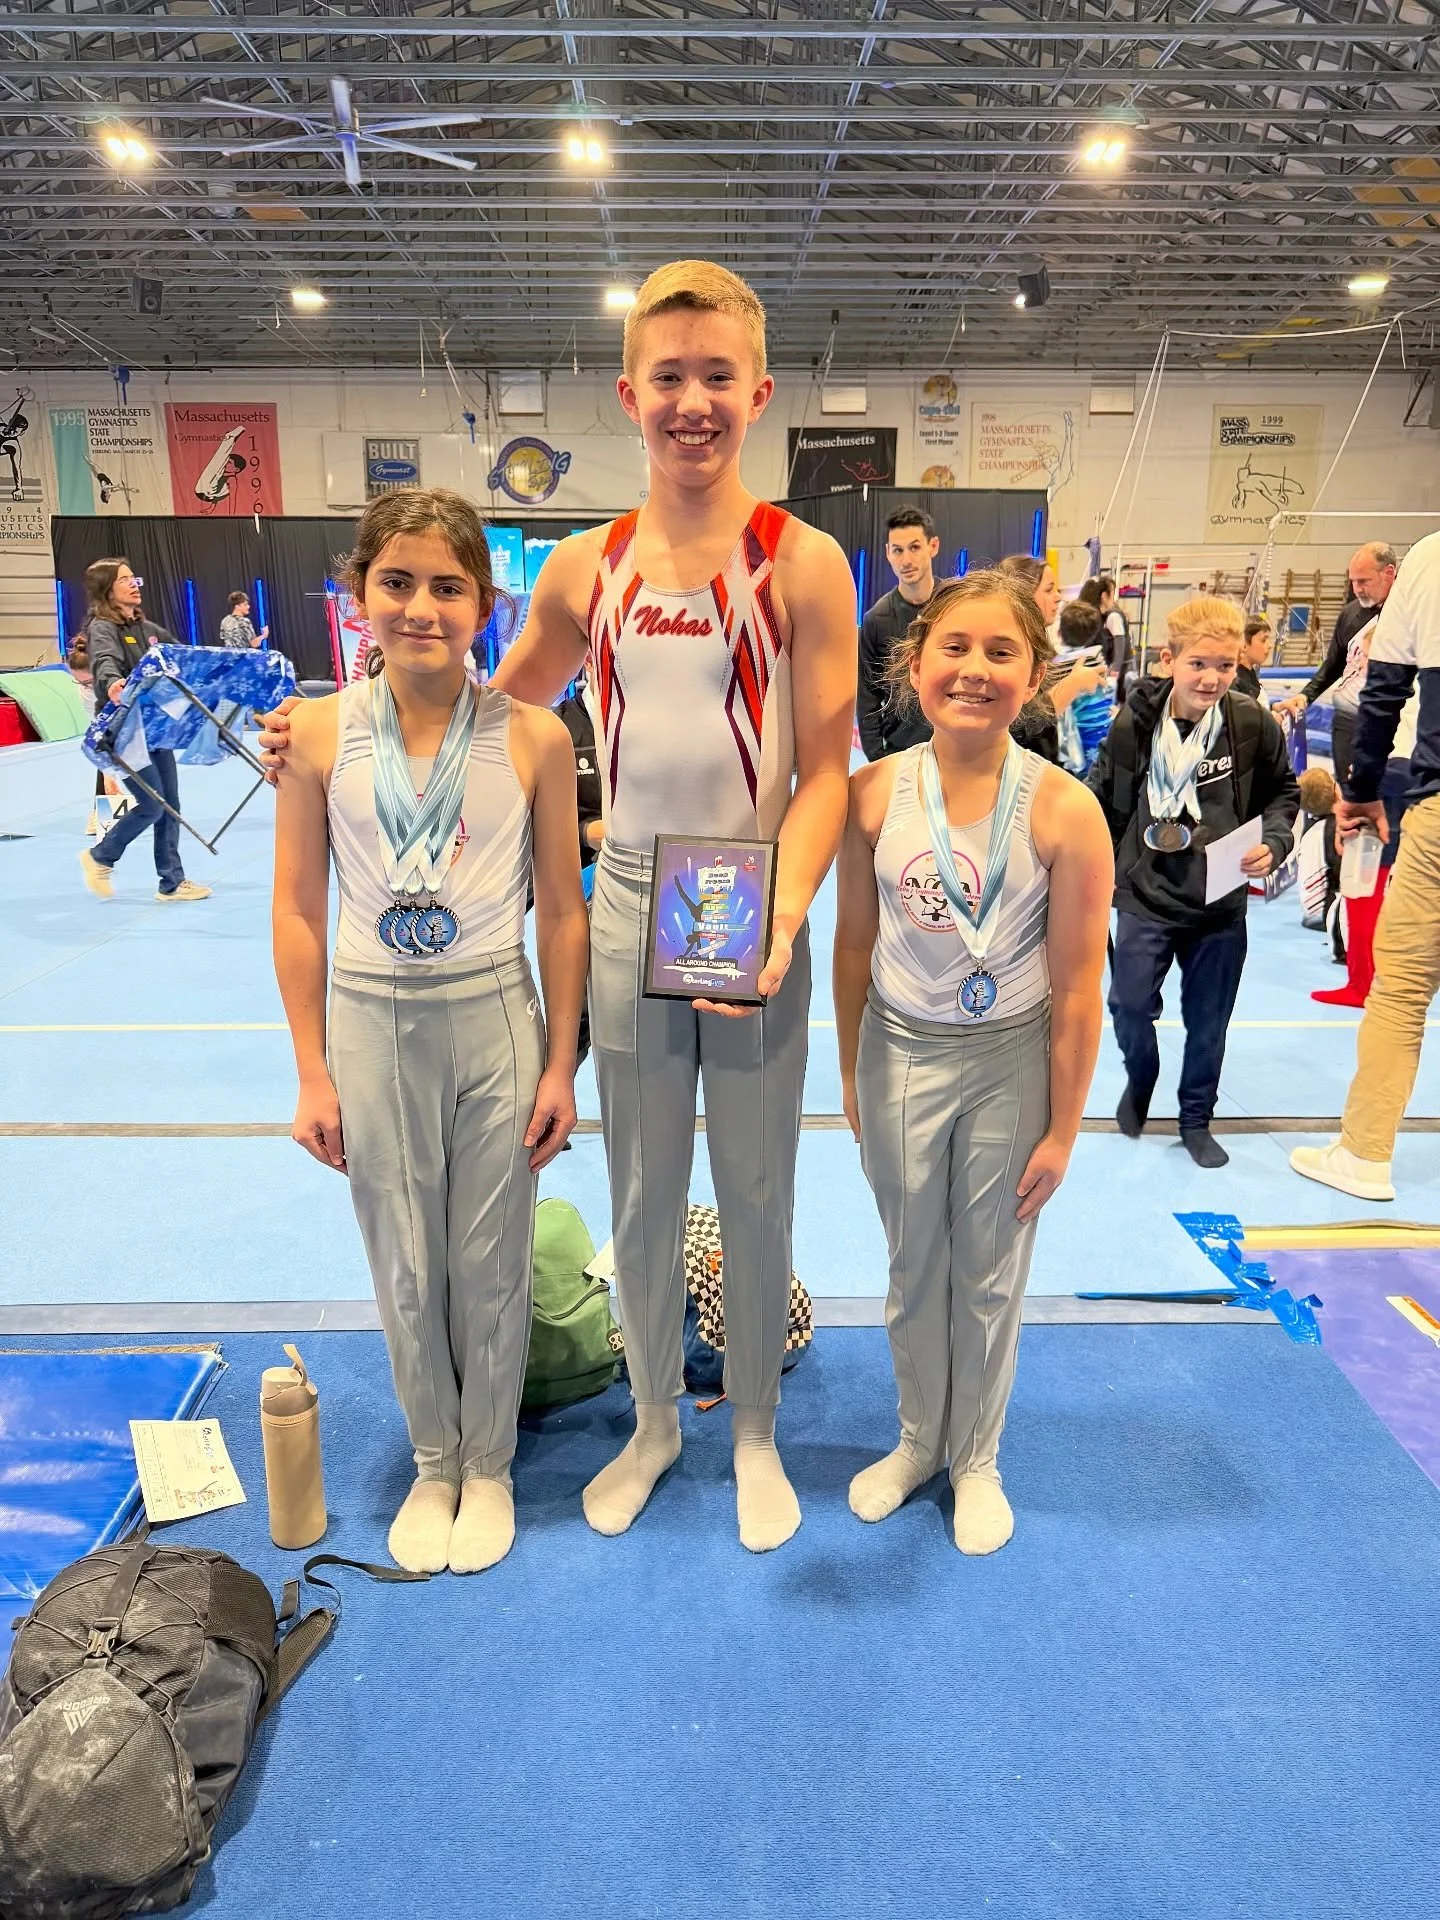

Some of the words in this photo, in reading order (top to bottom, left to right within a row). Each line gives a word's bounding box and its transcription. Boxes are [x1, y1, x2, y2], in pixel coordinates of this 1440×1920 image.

[88, 408, 151, 417] MASSACHUSETTS
[174, 410, 270, 423] Massachusetts
[50, 411, 85, 426] 1995
[88, 418, 138, 427] GYMNASTICS
[1262, 415, 1283, 424] 1999
[89, 428, 110, 437] STATE
[980, 424, 1052, 435] MASSACHUSETTS
[90, 438, 153, 447] CHAMPIONSHIPS
[798, 435, 876, 450] Massachusetts
[979, 436, 1034, 447] GYMNASTICS
[368, 442, 417, 460] BUILT
[979, 448, 1004, 459] STATE
[633, 604, 713, 637] Nohas
[112, 798, 128, 819] 4
[708, 960, 736, 969] CHAMPION
[54, 1696, 111, 1710] GREGORY
